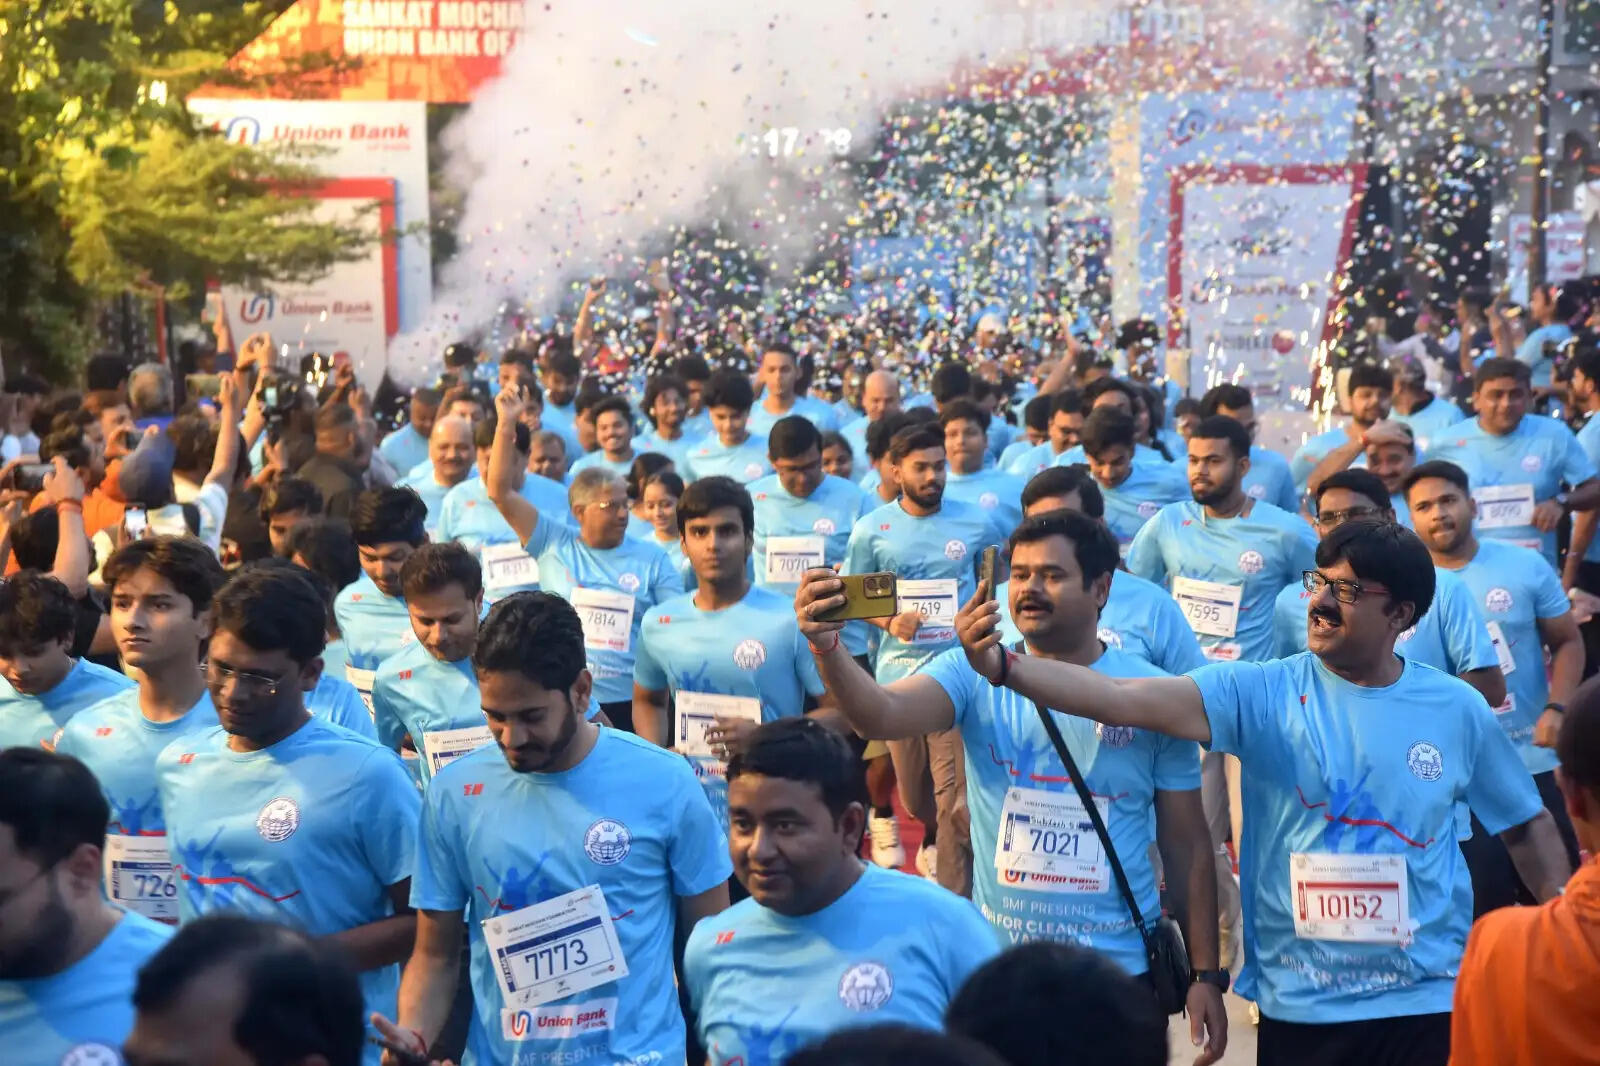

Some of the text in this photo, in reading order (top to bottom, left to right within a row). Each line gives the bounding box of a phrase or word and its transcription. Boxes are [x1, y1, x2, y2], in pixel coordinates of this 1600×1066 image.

[343, 28, 415, 56] UNION
[419, 29, 480, 56] BANK
[273, 123, 411, 141] Union Bank
[282, 300, 373, 316] Union Bank
[779, 557, 810, 572] 7070
[912, 601, 942, 616] 7619
[1187, 602, 1221, 622] 7595
[587, 611, 617, 628] 7814
[1030, 829, 1079, 857] 7021
[1030, 901, 1096, 916] PRESENTS
[1317, 894, 1383, 920] 10152
[1026, 919, 1079, 936] CLEAN
[524, 938, 589, 980] 7773
[537, 1008, 606, 1028] Union Bank
[541, 1044, 608, 1066] PRESENTS
